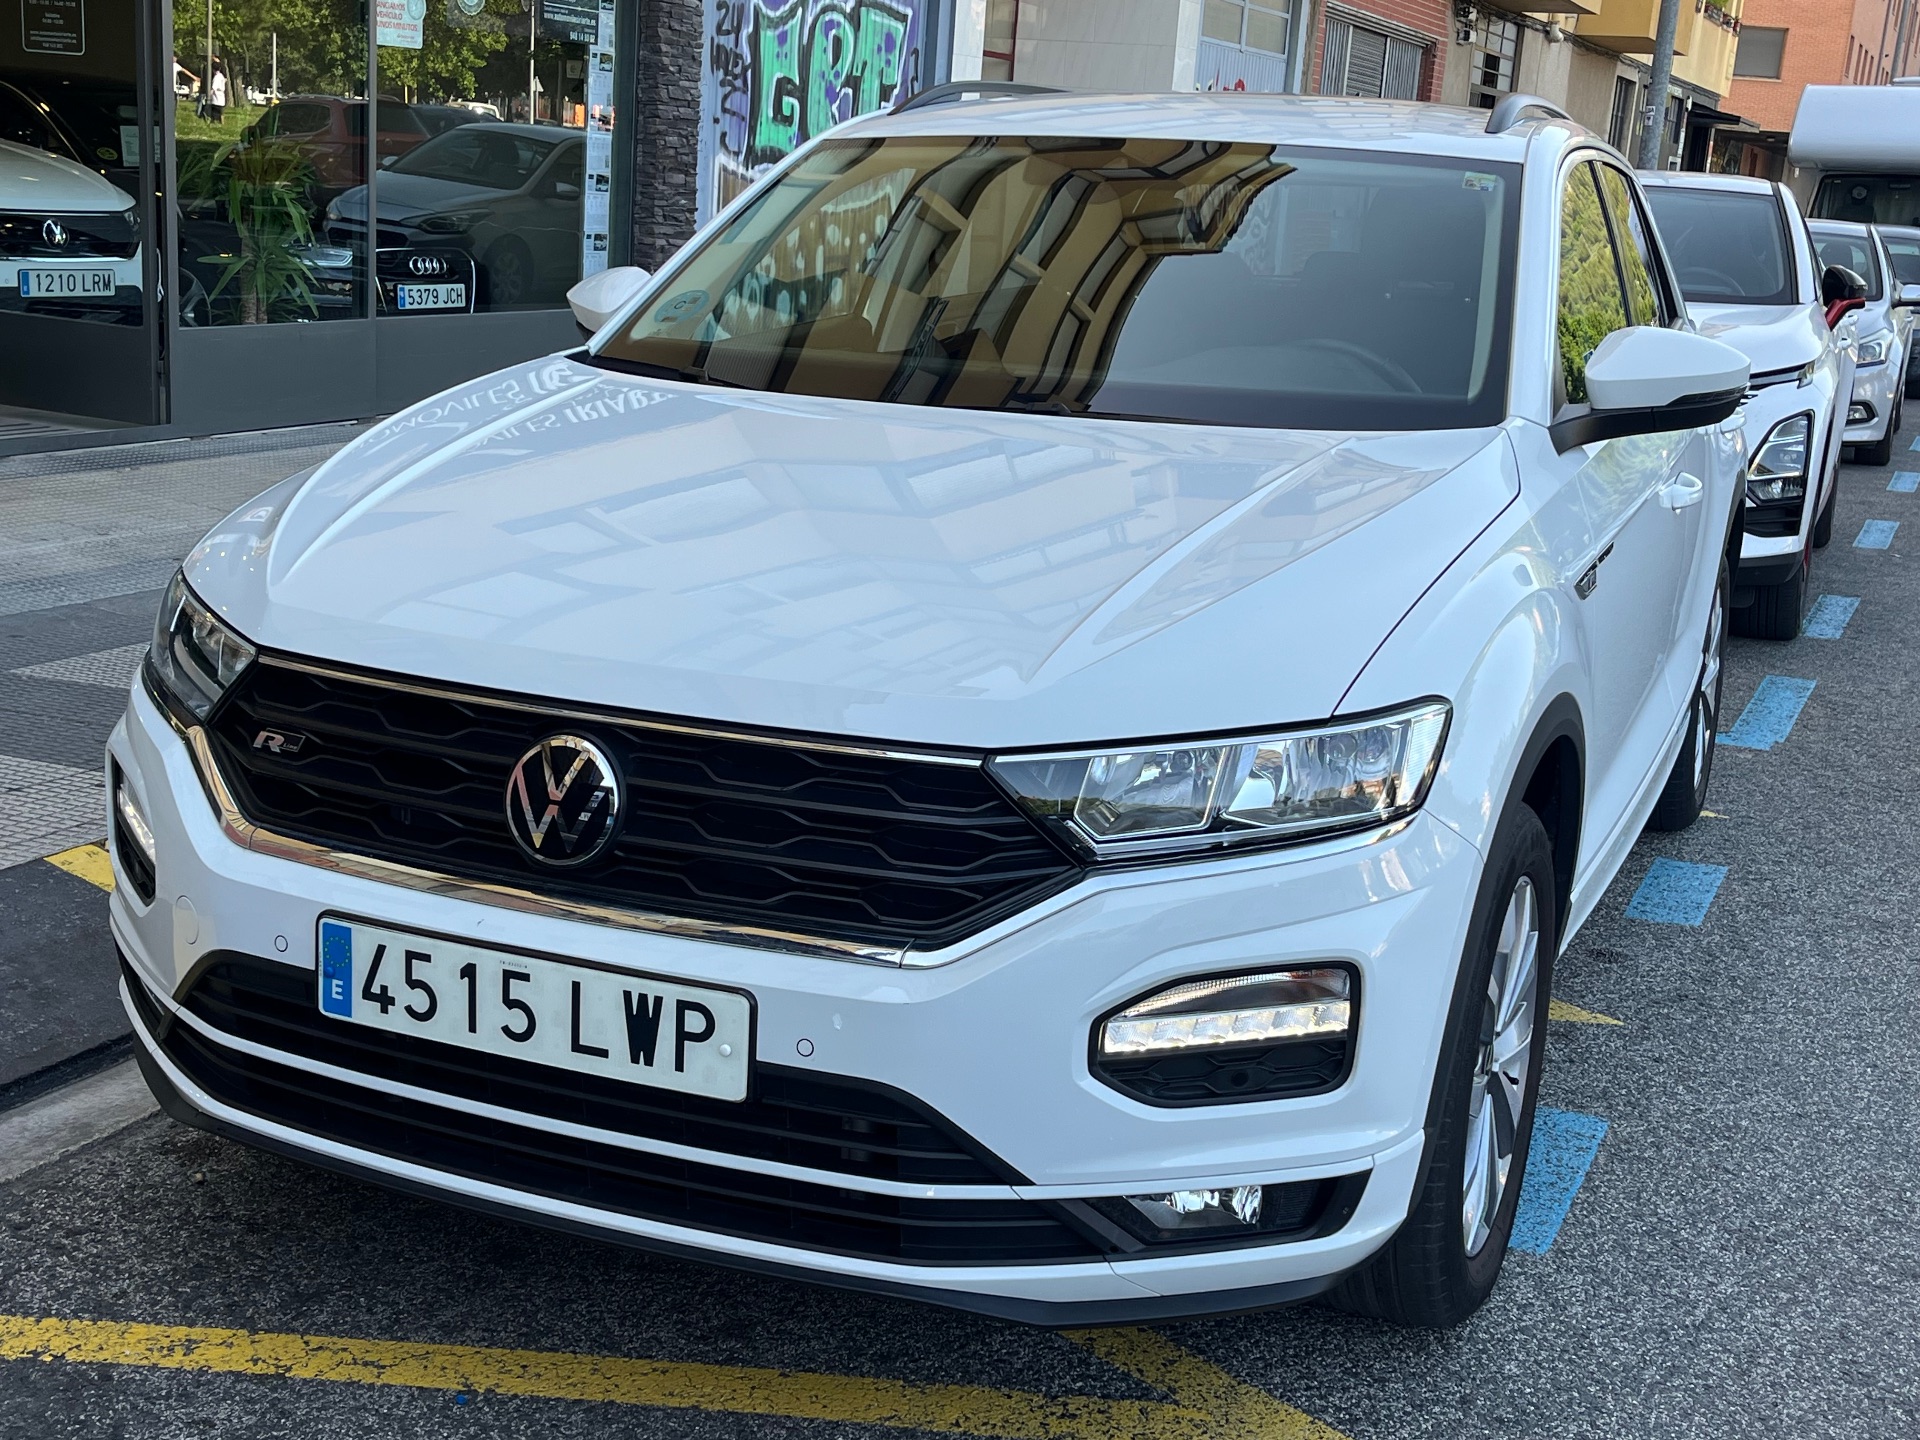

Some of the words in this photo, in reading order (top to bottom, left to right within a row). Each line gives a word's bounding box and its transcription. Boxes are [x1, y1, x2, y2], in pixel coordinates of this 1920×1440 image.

[36, 273, 77, 292] 1210
[82, 273, 111, 292] LRM
[407, 288, 439, 306] 5379
[443, 287, 463, 304] JCH
[253, 731, 281, 753] R
[331, 979, 344, 1000] E
[362, 944, 537, 1043] 4515
[571, 980, 716, 1073] LWP
